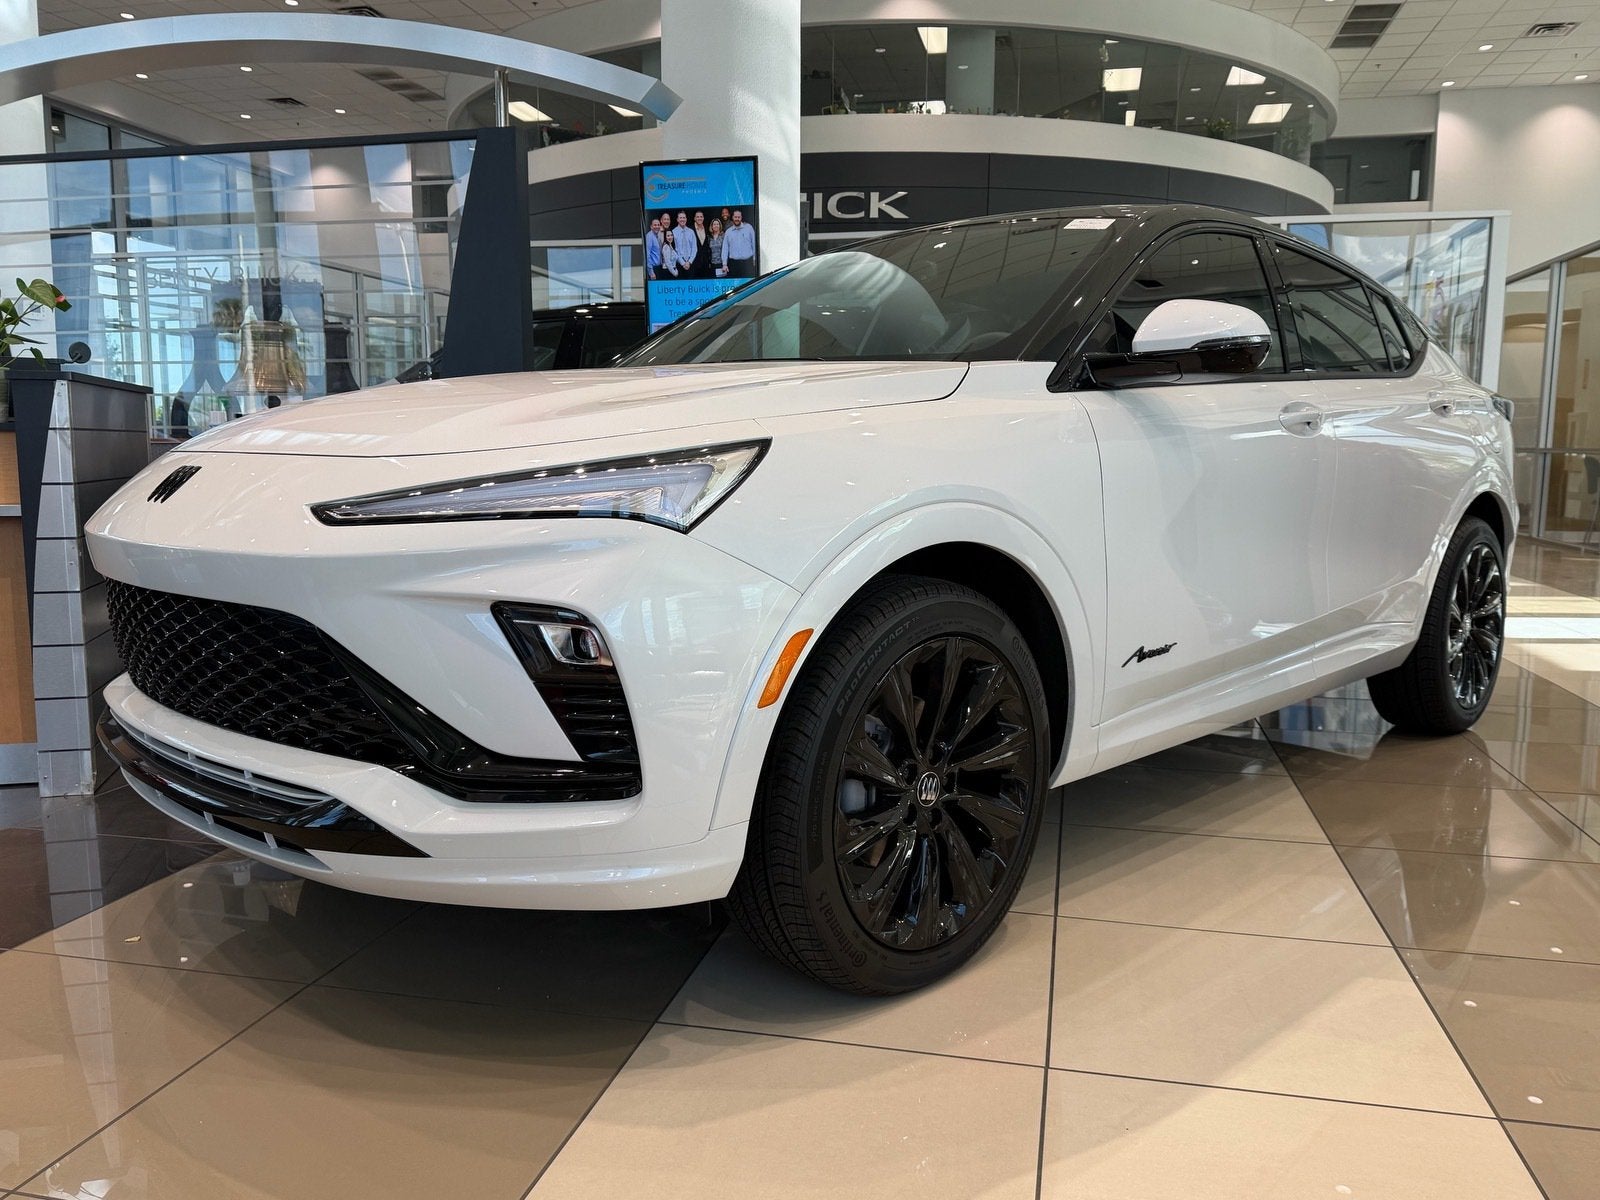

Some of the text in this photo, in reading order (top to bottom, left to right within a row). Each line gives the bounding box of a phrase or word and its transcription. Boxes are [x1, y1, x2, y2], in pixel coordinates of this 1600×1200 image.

[800, 191, 910, 219] ICK
[657, 285, 686, 296] Liberty
[688, 284, 711, 294] Buick
[713, 284, 720, 293] is
[675, 298, 686, 306] be
